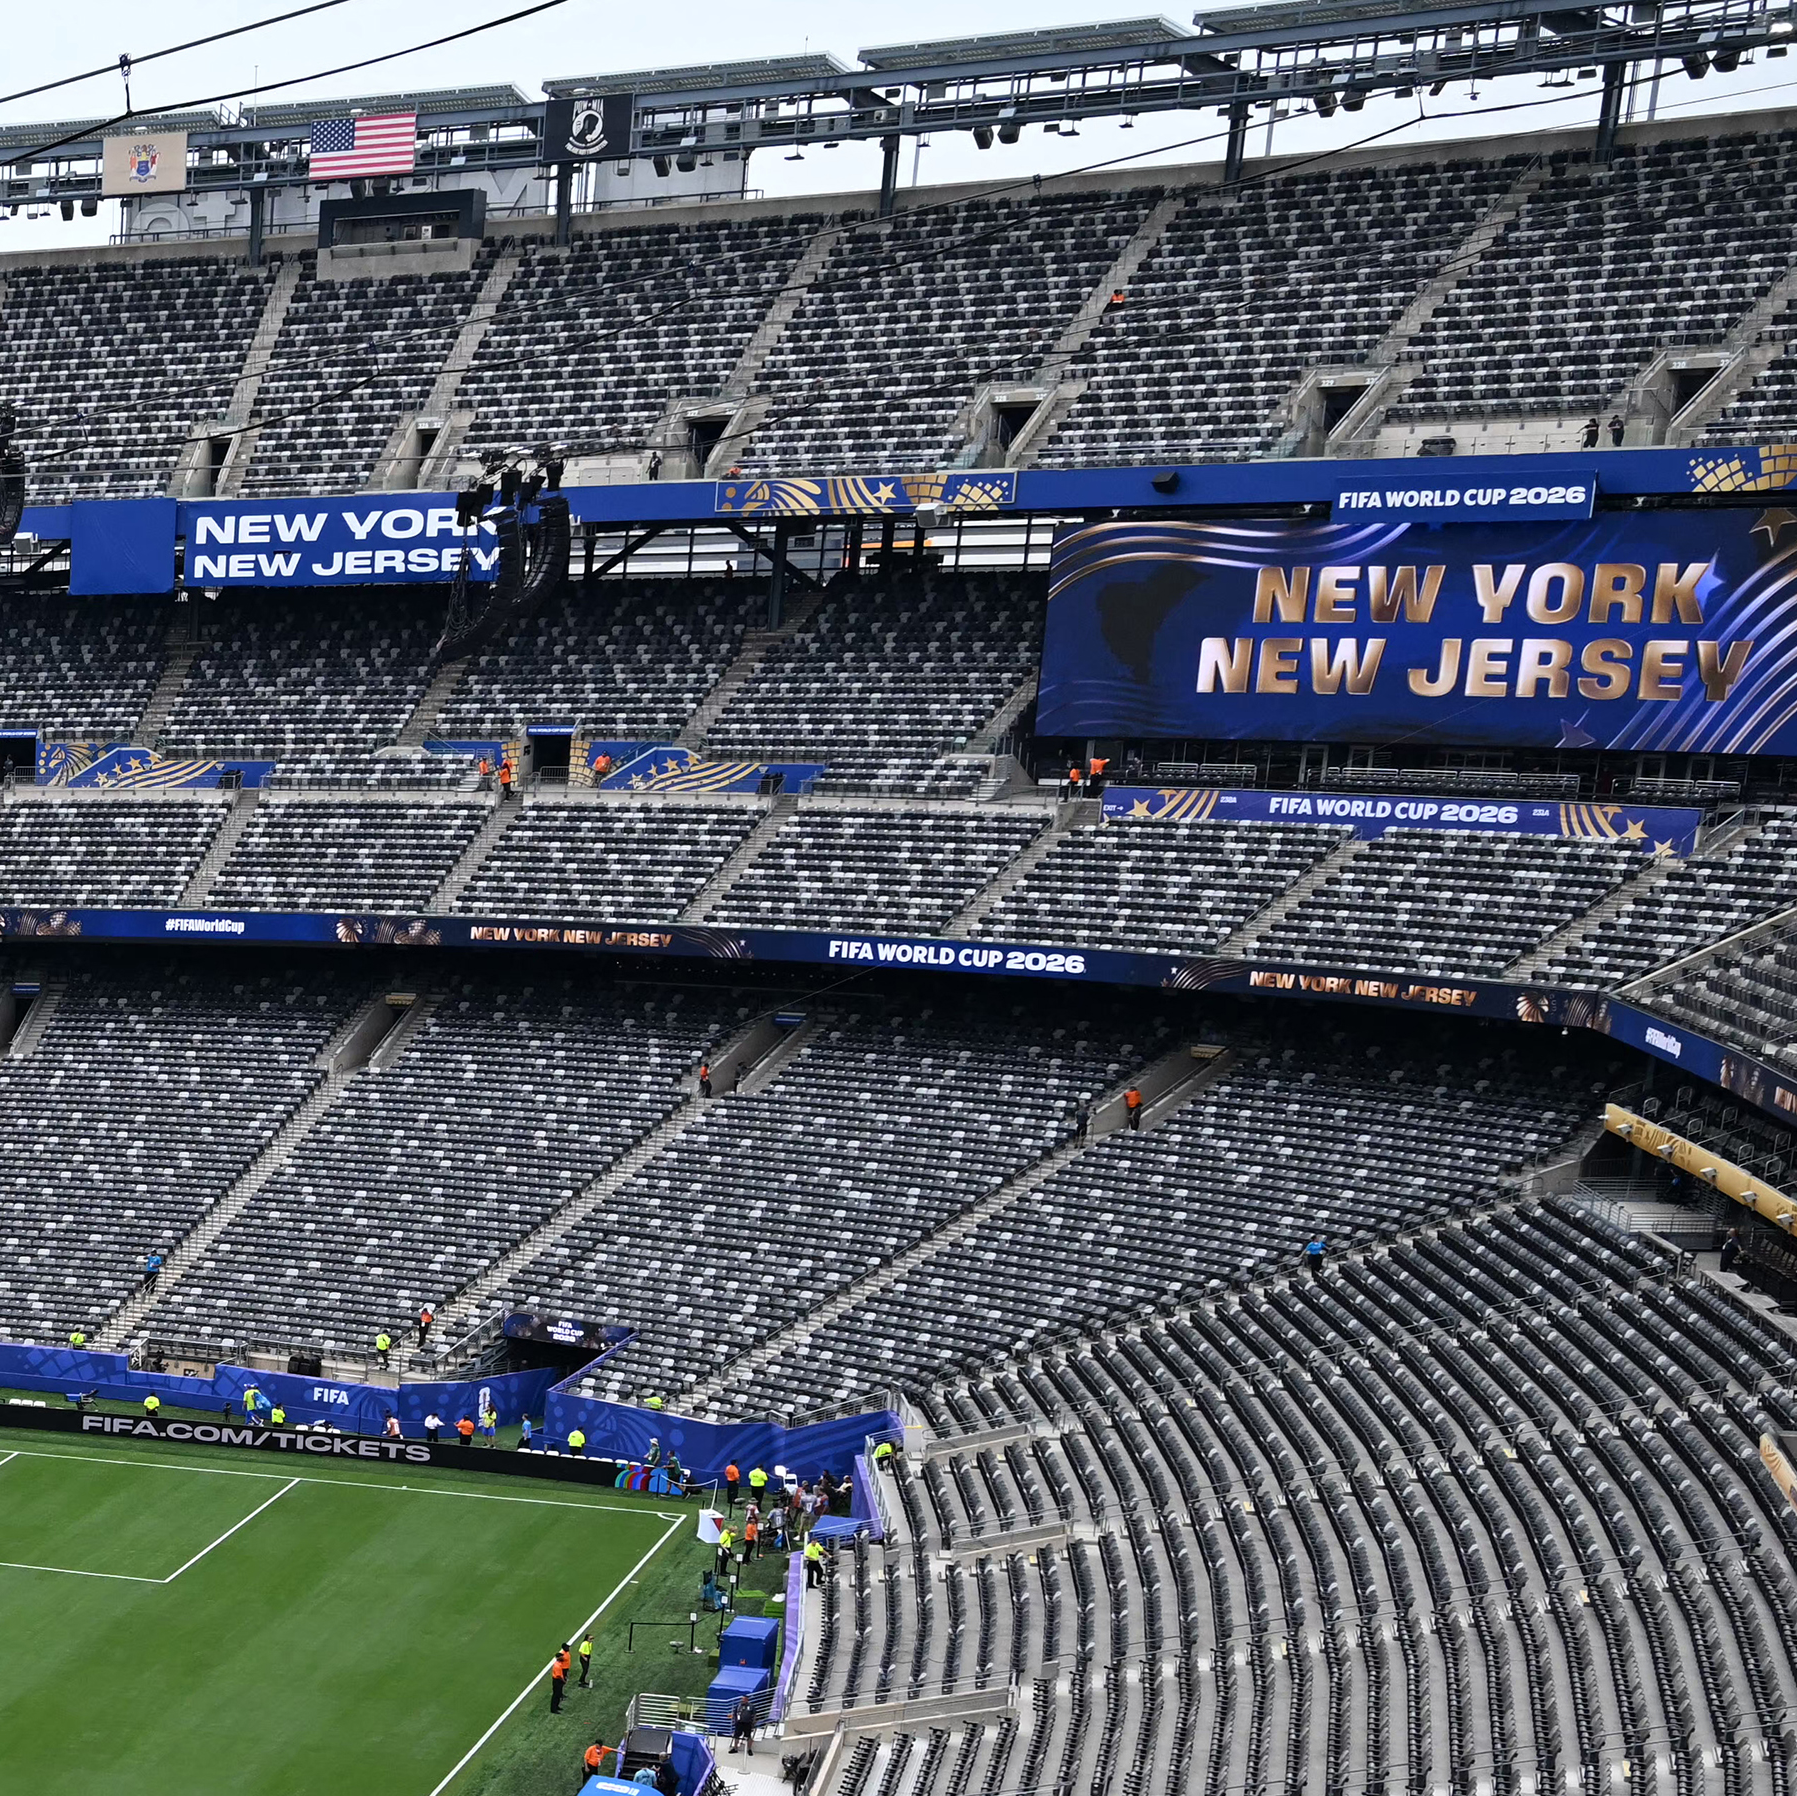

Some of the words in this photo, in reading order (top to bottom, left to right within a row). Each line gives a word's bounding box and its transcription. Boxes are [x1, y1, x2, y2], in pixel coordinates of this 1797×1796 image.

[1339, 492, 1380, 508] FIFA
[1386, 490, 1460, 507] WORLD
[1464, 489, 1506, 505] CUP
[1509, 487, 1585, 504] 2026
[196, 513, 329, 544] NEW
[194, 553, 301, 578] NEW
[312, 547, 500, 575] JERSEY
[1253, 565, 1446, 623] NEW
[1473, 563, 1702, 624] YORK
[1197, 638, 1386, 694] NEW
[1408, 638, 1754, 703] JERSEY
[1270, 798, 1312, 814] FIFA
[1317, 799, 1391, 817] WORLD
[1395, 802, 1438, 819] CUP
[1440, 804, 1518, 823] 2026
[165, 919, 244, 934] #FIFAWorldCup
[471, 927, 509, 941] NEW
[514, 928, 560, 942] YORK
[564, 930, 600, 944] NEW
[606, 932, 671, 947] JERSEY
[829, 941, 873, 959] FIFA
[878, 944, 955, 964] WORLD
[959, 949, 1003, 967] CUP
[1006, 952, 1084, 973] 2026
[1250, 971, 1295, 988] NEW
[1299, 975, 1350, 993] YORK
[1355, 980, 1397, 997] NEW
[1403, 985, 1476, 1007] JERSEY
[547, 1326, 570, 1336] WORLD
[570, 1329, 584, 1337] CUP
[558, 1321, 572, 1329] FIFA
[314, 1387, 349, 1405] FIFA
[82, 1416, 430, 1461] FIFA.COM/TICKETS
